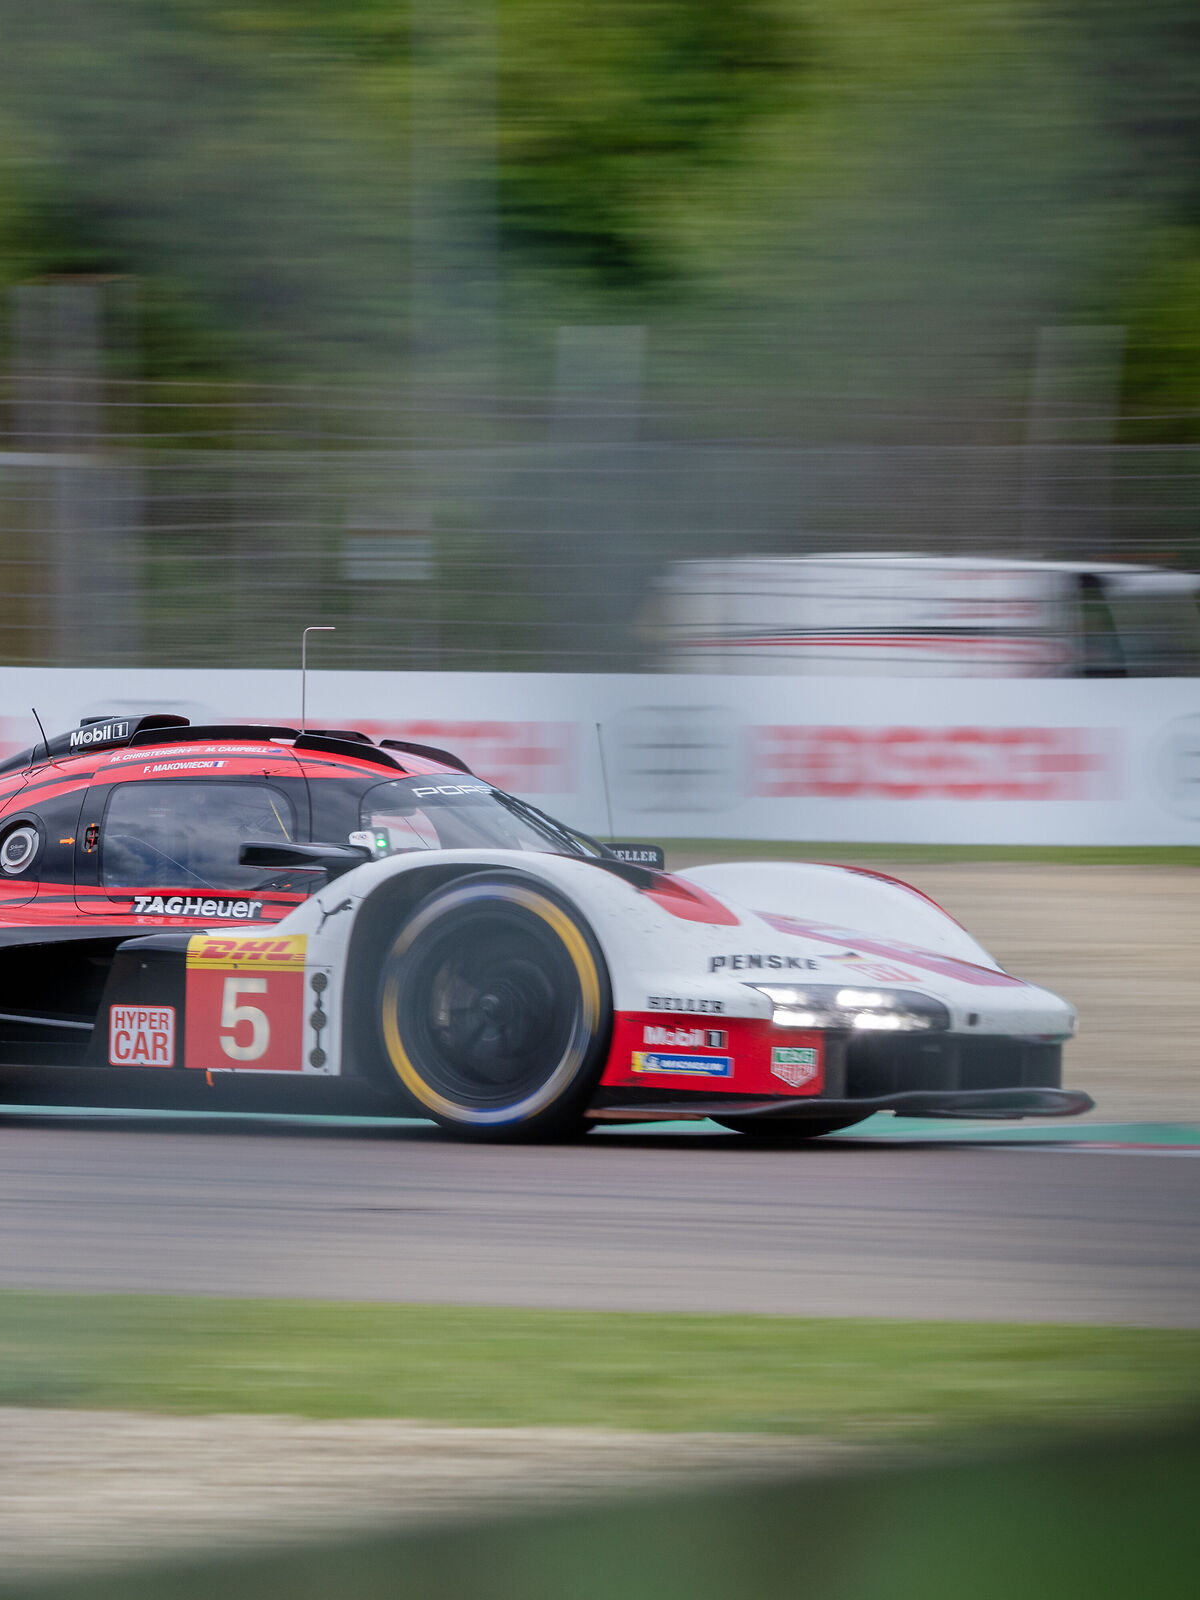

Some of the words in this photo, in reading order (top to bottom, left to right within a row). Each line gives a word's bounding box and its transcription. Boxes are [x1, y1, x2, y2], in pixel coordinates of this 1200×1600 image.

[70, 725, 111, 747] Mobil
[122, 748, 186, 761] CHRISTENSEN
[143, 765, 151, 774] F.
[152, 761, 213, 773] MAKOWIECKI
[412, 785, 492, 798] PORS
[612, 849, 658, 862] ELLER
[200, 940, 296, 961] DHL
[709, 955, 819, 973] PENSKE
[114, 1011, 169, 1031] HYPER
[219, 977, 271, 1062] 5
[114, 1030, 169, 1061] CAR
[643, 1026, 705, 1047] Mobil
